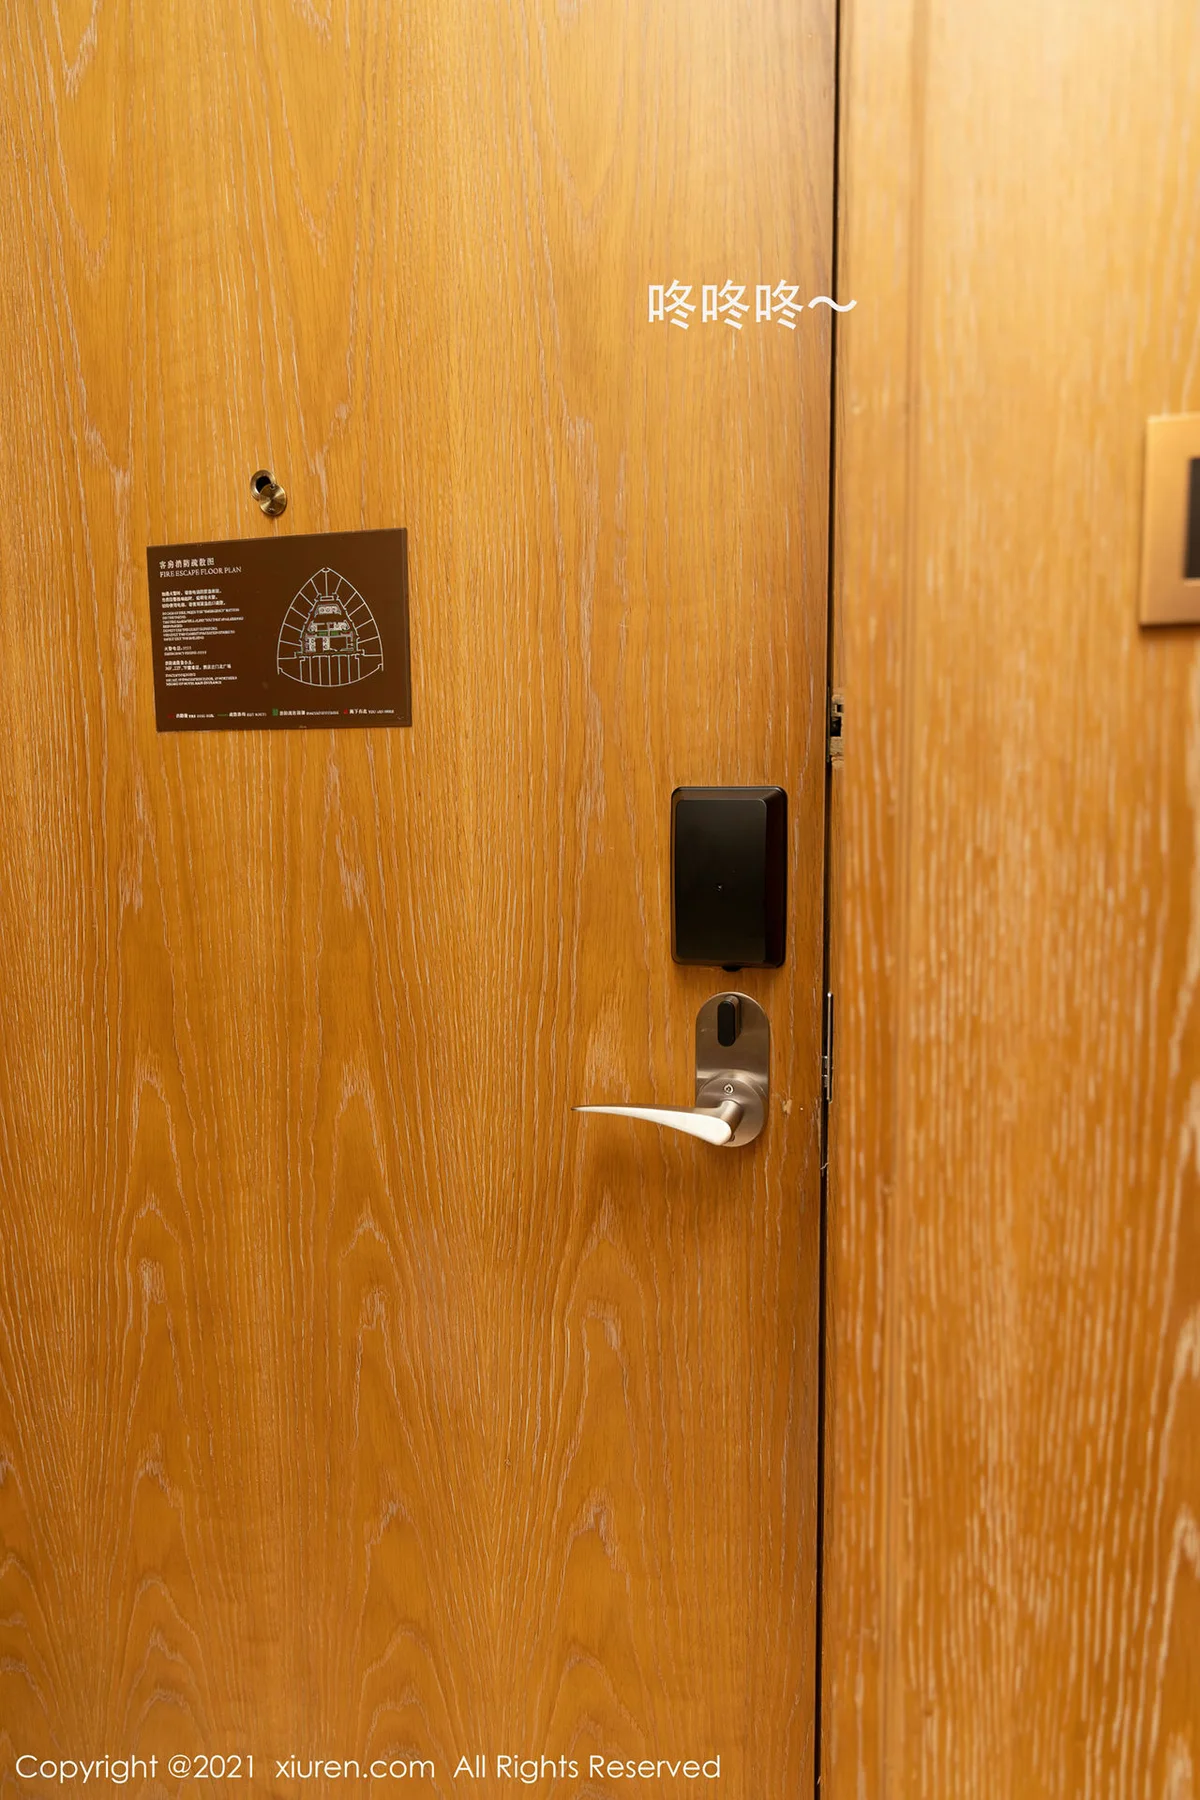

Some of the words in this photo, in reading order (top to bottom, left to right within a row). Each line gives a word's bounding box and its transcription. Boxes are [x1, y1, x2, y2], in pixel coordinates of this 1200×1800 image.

[159, 570, 175, 578] FIRE
[175, 569, 199, 577] ESCAPE
[200, 567, 223, 576] FLOOR
[224, 566, 242, 574] PLAN
